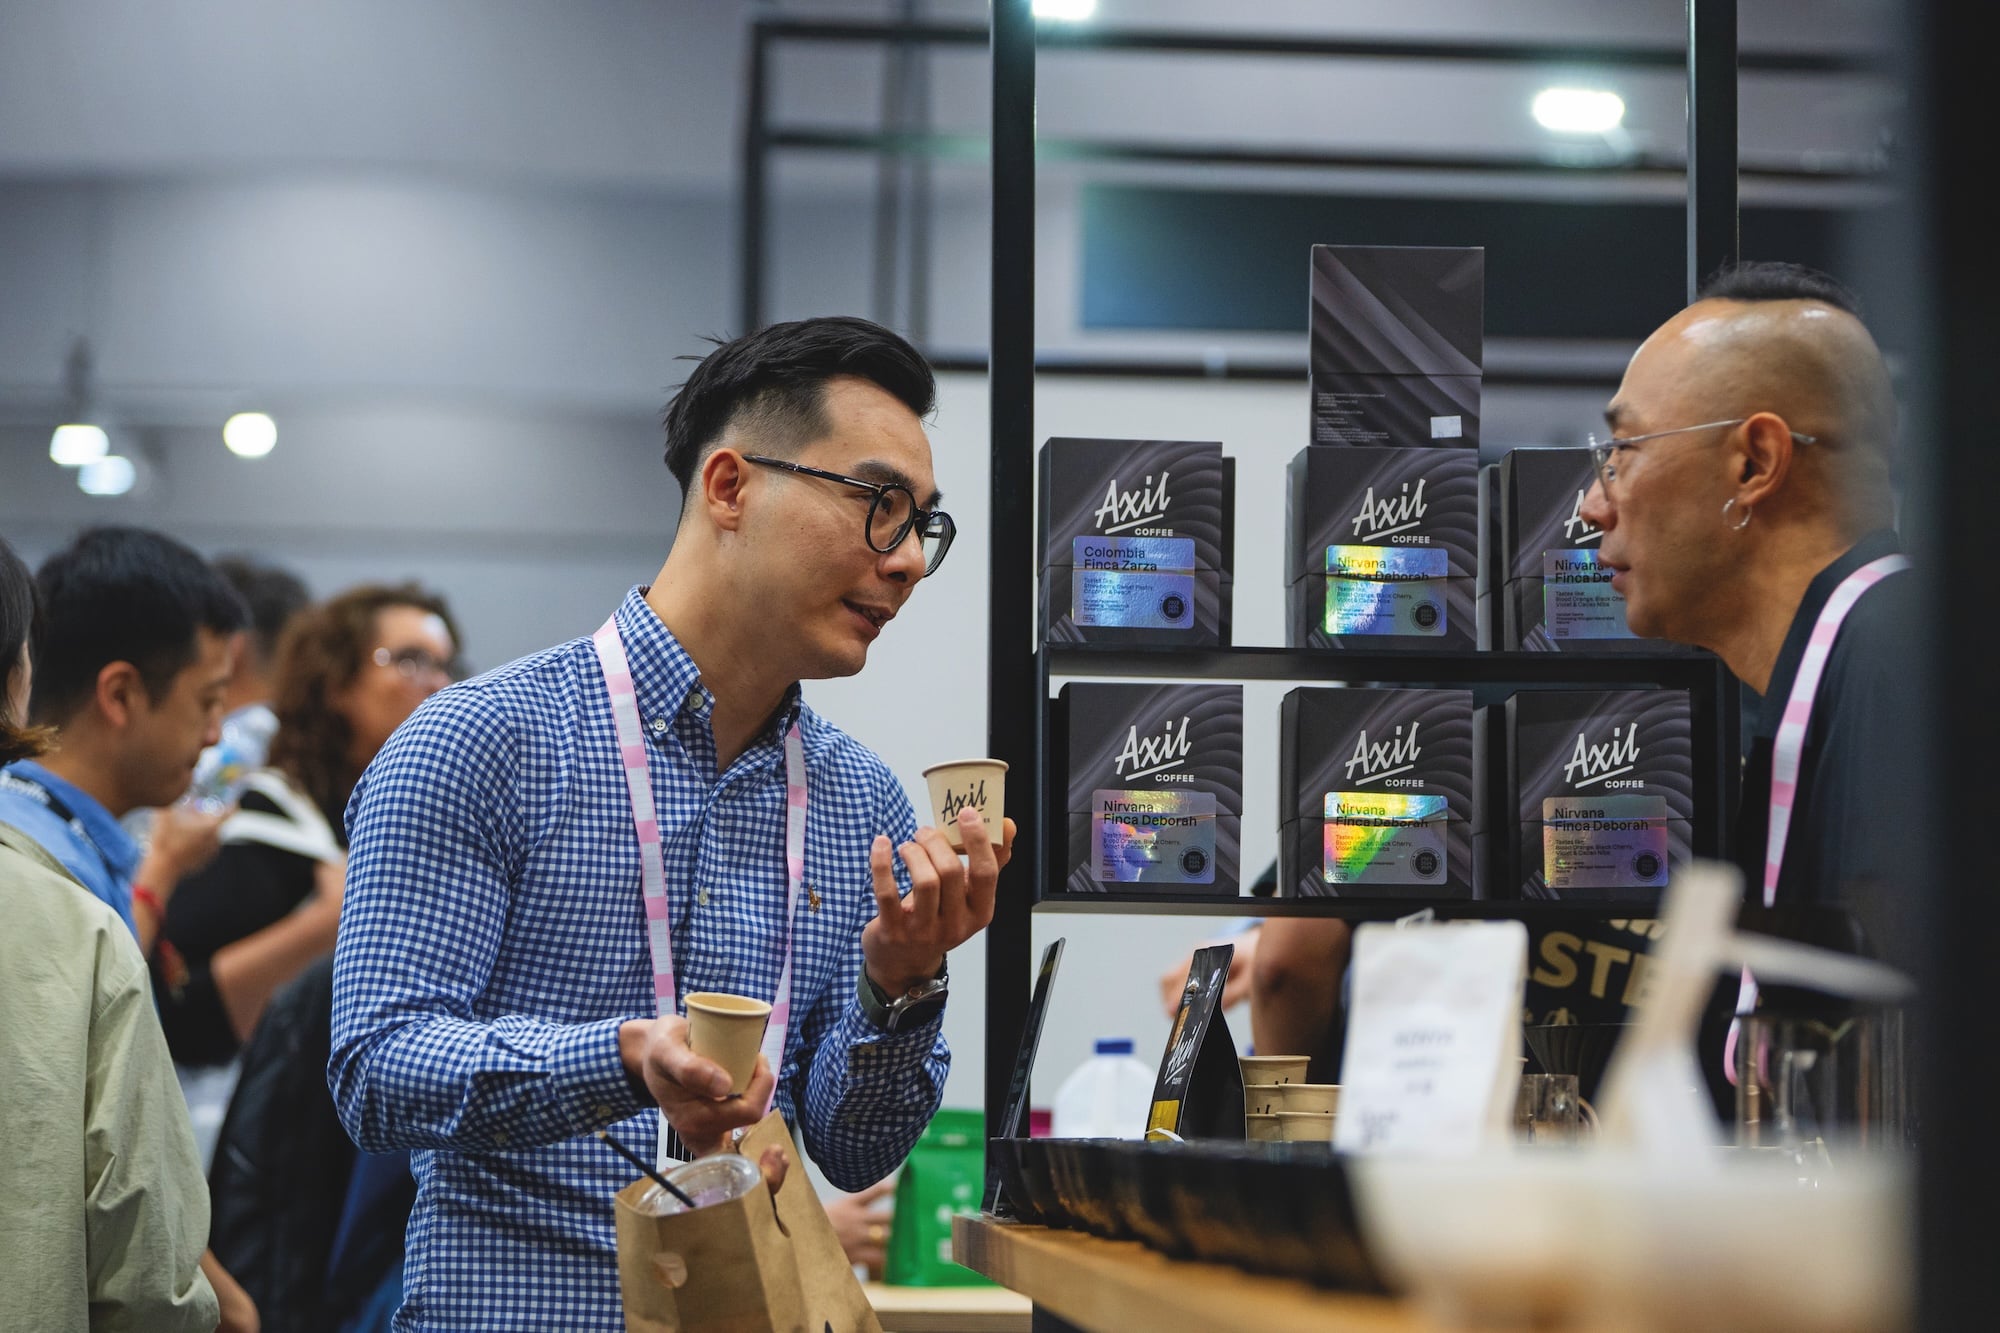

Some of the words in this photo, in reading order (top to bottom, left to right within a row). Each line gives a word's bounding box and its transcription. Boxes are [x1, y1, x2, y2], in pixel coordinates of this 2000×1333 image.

[1095, 471, 1171, 529] Axil
[1352, 478, 1428, 536] Axil
[1134, 528, 1174, 537] COFFEE
[1391, 535, 1431, 544] COFFEE
[1084, 546, 1145, 559] Colombia
[1084, 558, 1119, 570] Finca
[1122, 560, 1158, 571] Zarza
[1338, 557, 1387, 569] Nirvana
[1555, 559, 1604, 571] Nirvana
[1375, 570, 1429, 582] Deborah
[1555, 572, 1590, 584] Finca
[1115, 716, 1192, 775] Axil
[1345, 721, 1422, 780] Axil
[1564, 722, 1640, 783] Axil
[1155, 774, 1195, 783] COFFEE
[1385, 779, 1425, 788] COFFEE
[1604, 780, 1645, 789] COFFEE
[942, 780, 987, 822] Axil
[1104, 800, 1154, 812] Nirvana
[1336, 803, 1386, 816] Nirvana
[1555, 808, 1605, 819] Nirvana
[1103, 813, 1138, 825] Finca
[1142, 814, 1197, 827] Deborah
[1336, 816, 1370, 827] Finca
[1373, 817, 1429, 828] Deborah
[1555, 820, 1590, 831] Finca
[1593, 820, 1649, 831] Deborah
